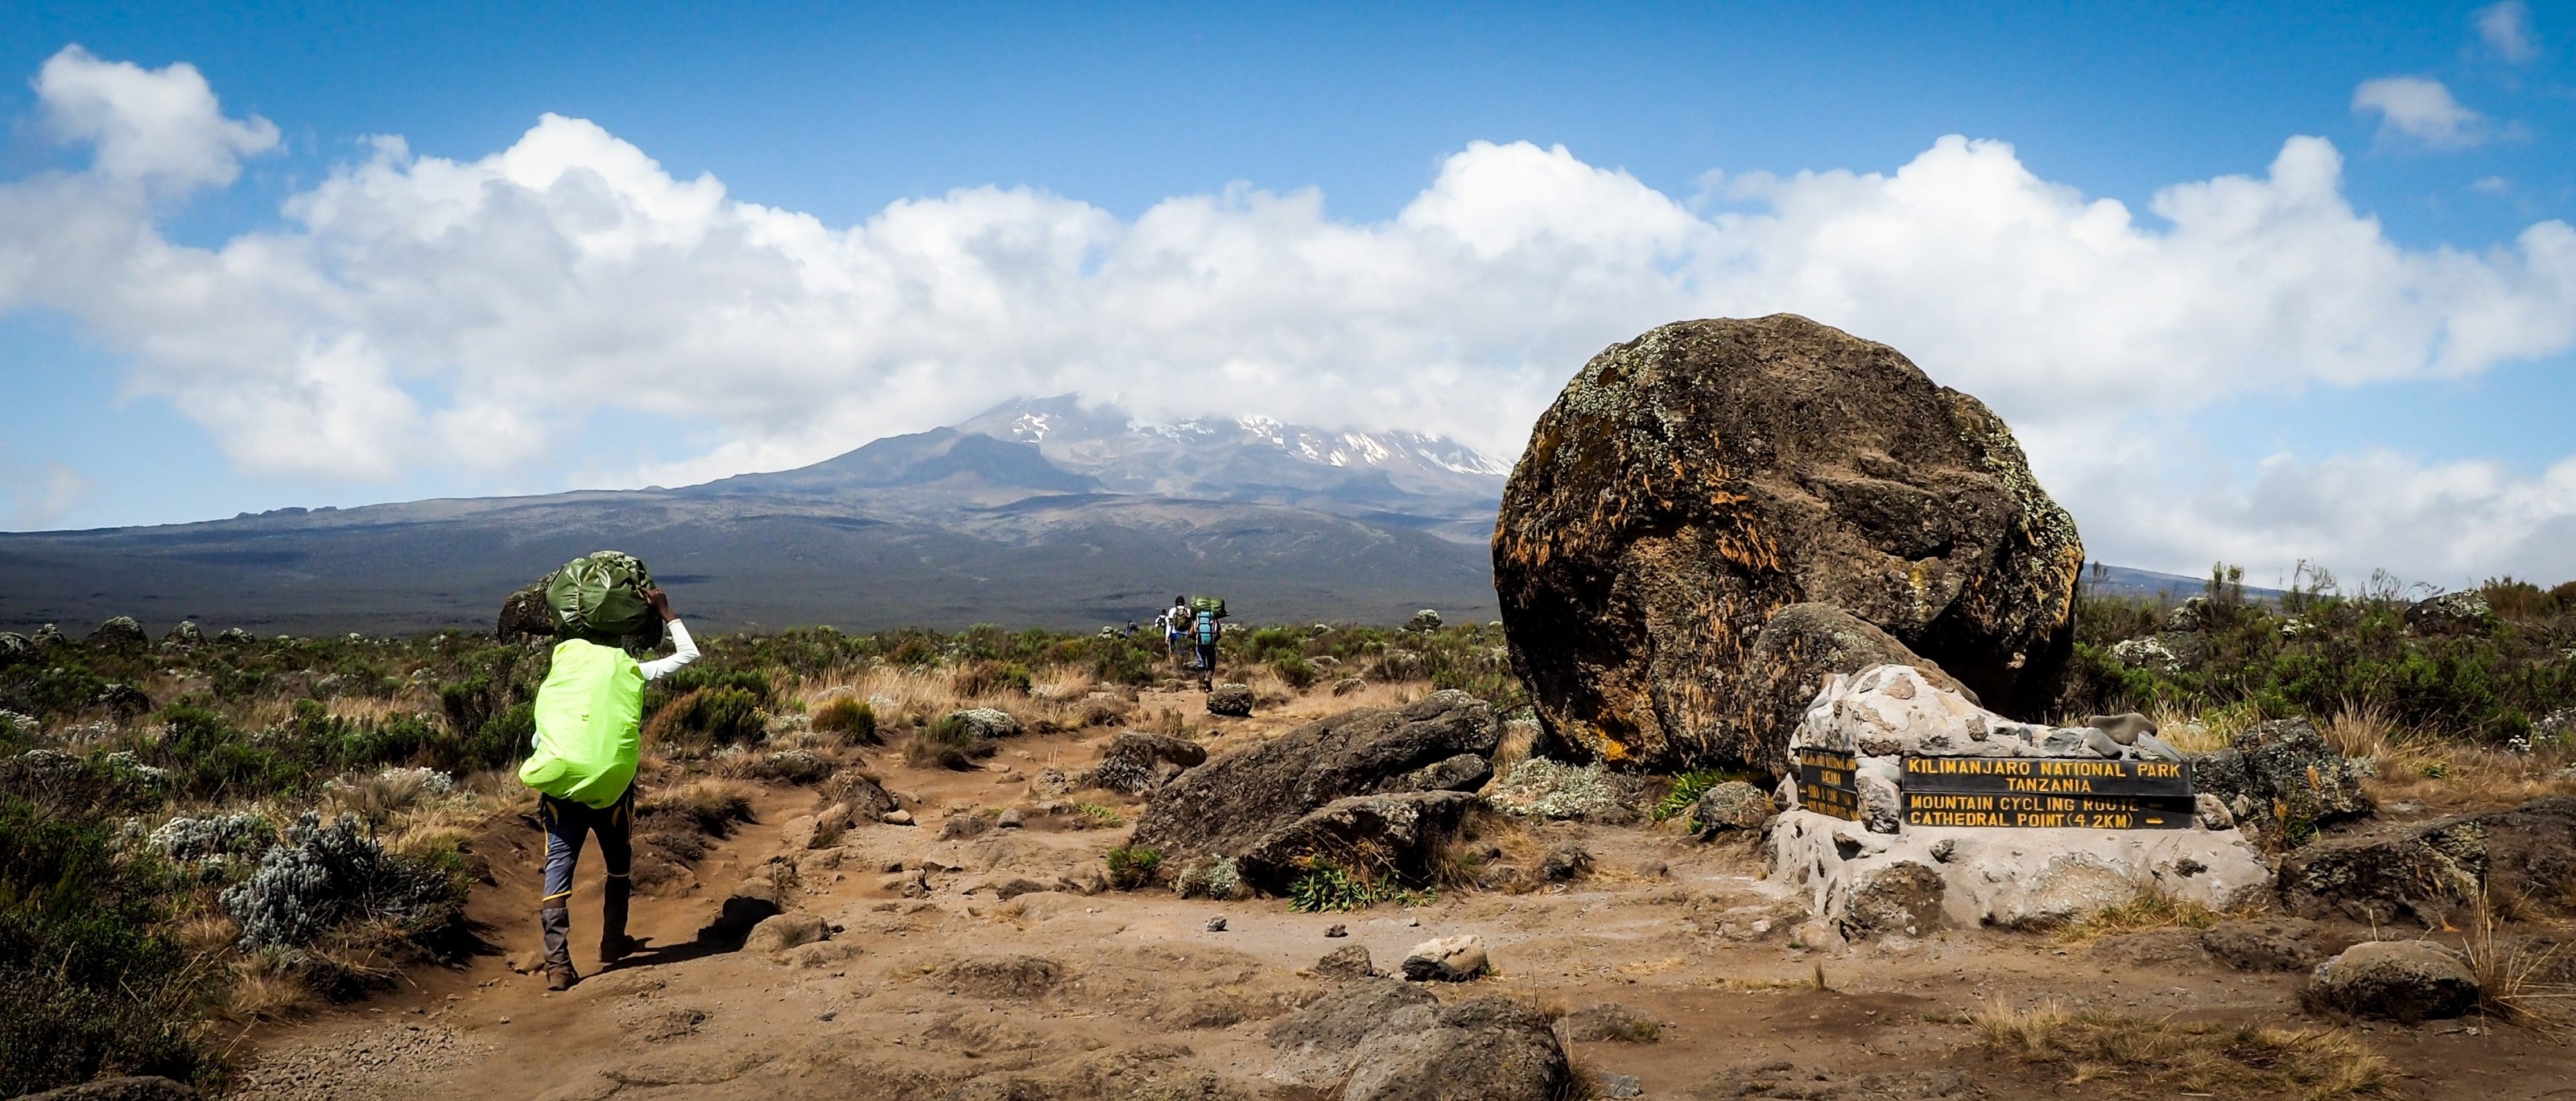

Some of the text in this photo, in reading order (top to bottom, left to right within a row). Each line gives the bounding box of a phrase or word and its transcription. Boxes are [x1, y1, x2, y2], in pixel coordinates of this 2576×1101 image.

[1908, 758, 2182, 778] KILIMANJARO NATIONAL PARK
[2005, 777, 2092, 793] TANZANIA
[1910, 794, 2139, 812] MOUNTAIN CYCLING ROUTE
[1909, 810, 2010, 827] CATHEDRAL
